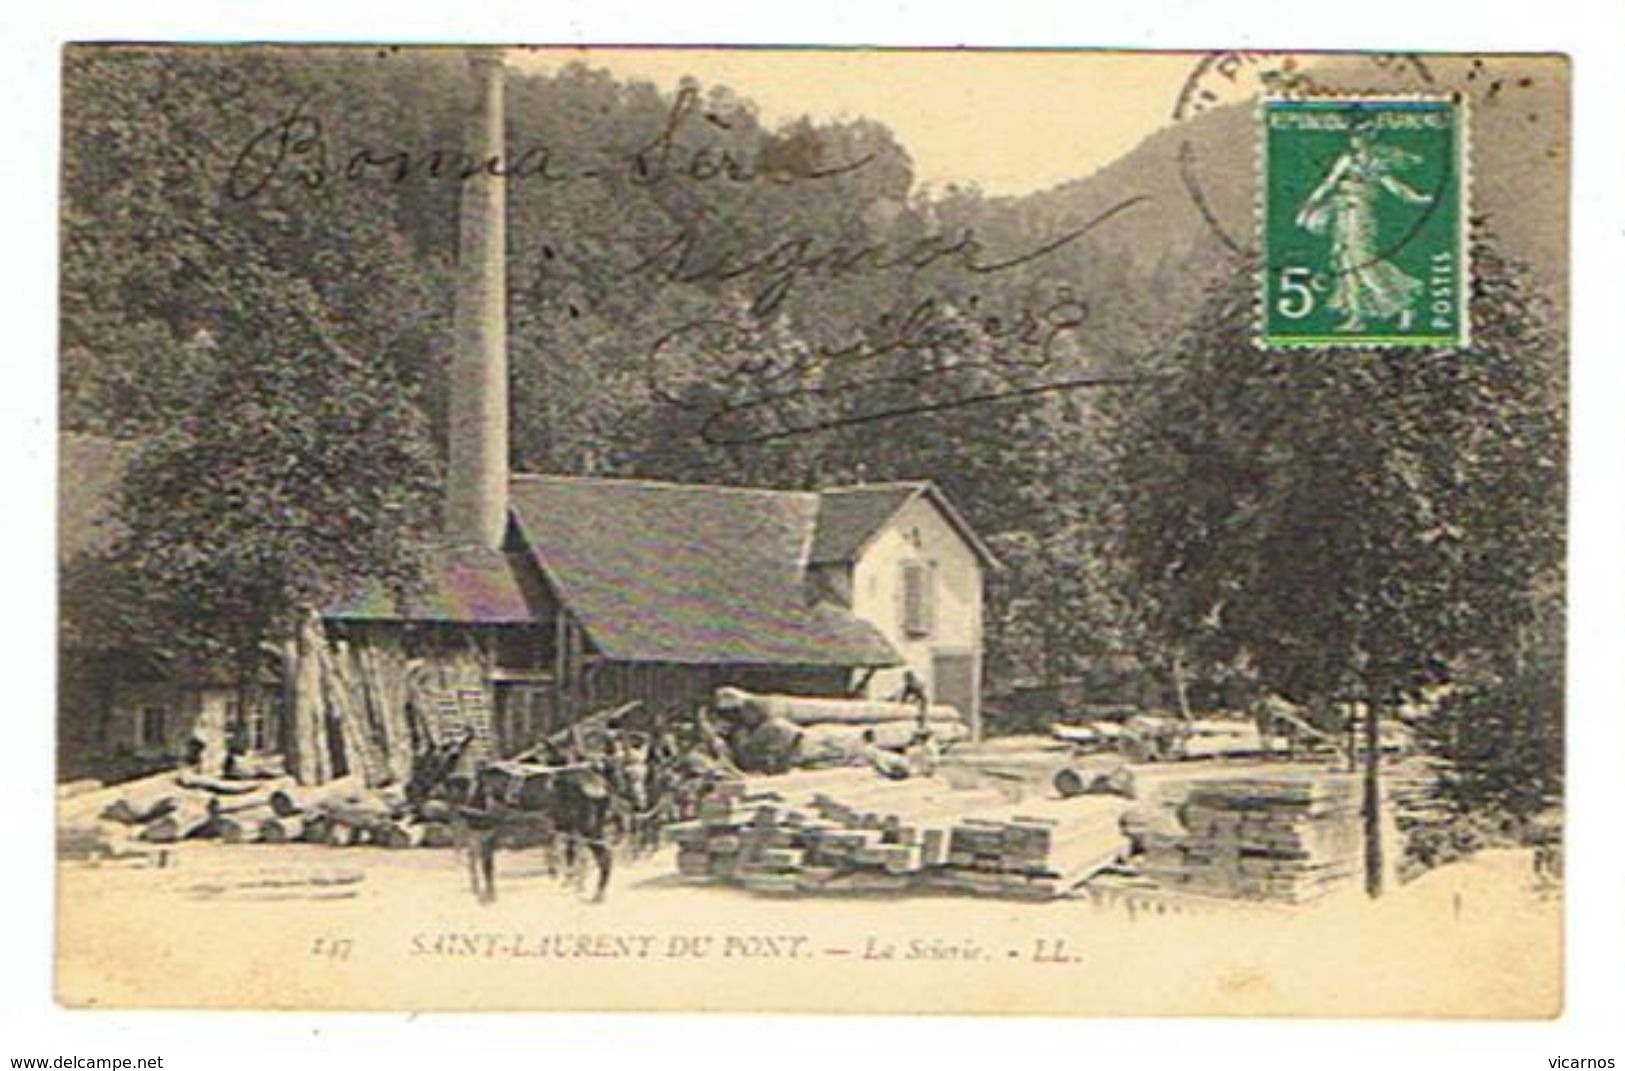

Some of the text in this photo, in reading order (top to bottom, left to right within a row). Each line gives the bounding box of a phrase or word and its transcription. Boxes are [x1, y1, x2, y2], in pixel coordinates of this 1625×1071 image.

[409, 933, 656, 958] SAINT-LAURENT
[665, 934, 713, 958] DU
[862, 936, 896, 961] La
